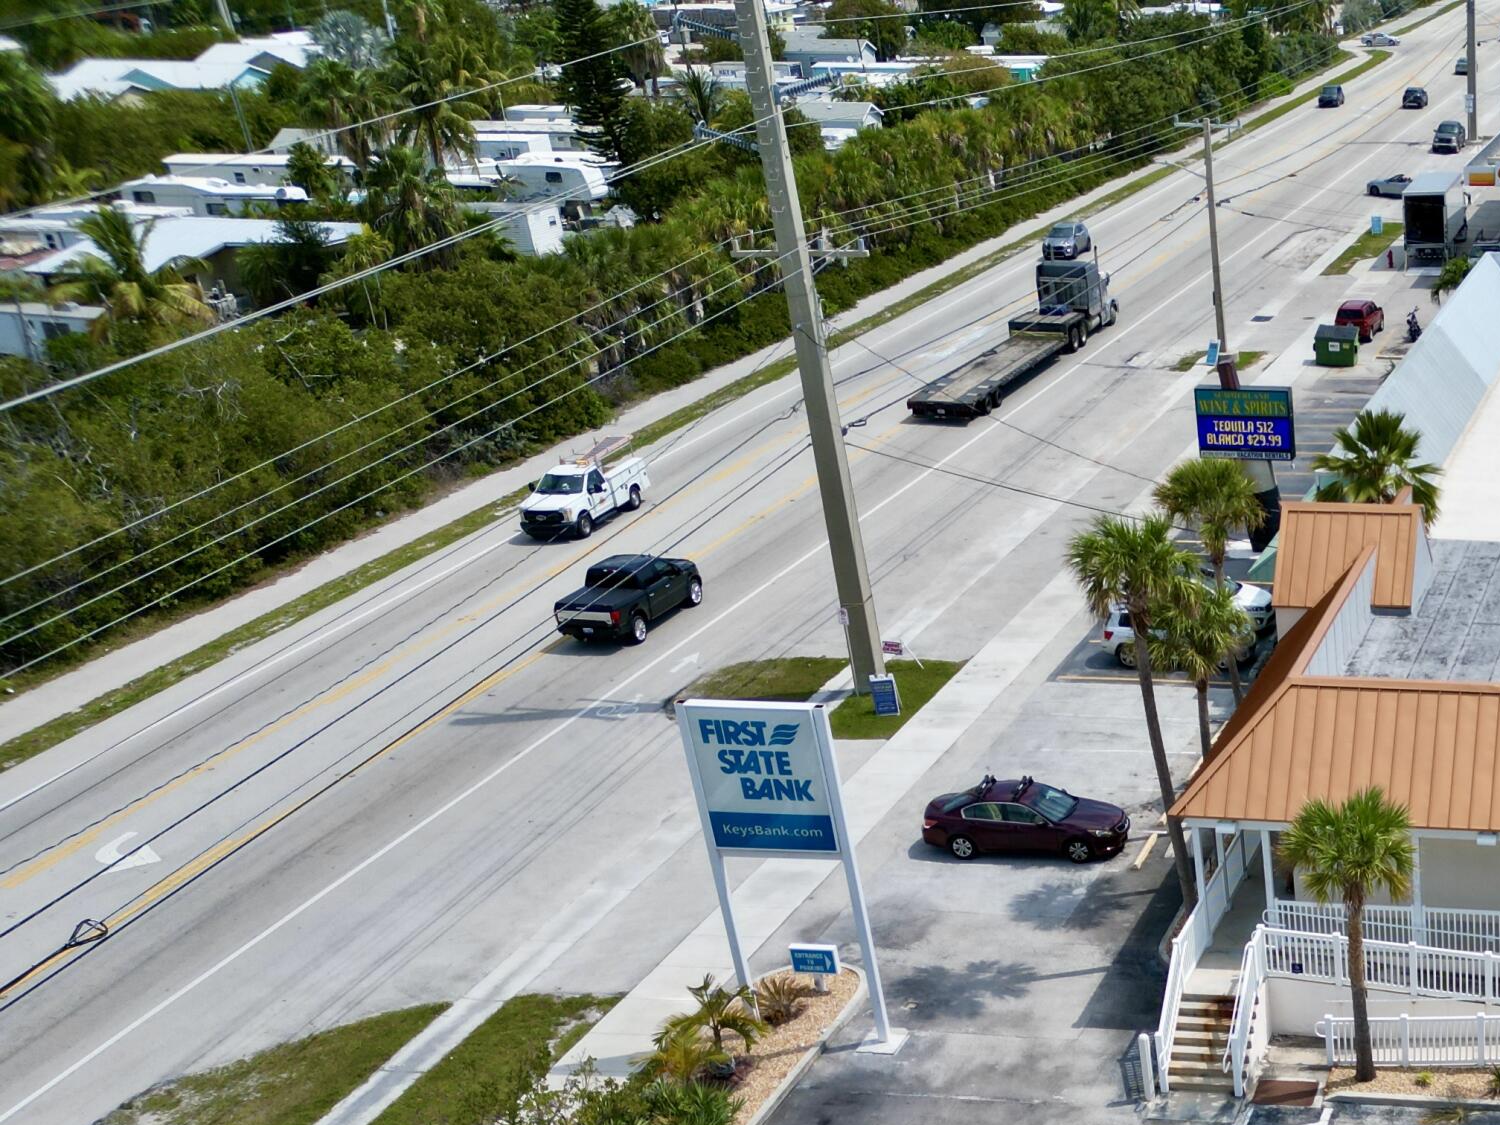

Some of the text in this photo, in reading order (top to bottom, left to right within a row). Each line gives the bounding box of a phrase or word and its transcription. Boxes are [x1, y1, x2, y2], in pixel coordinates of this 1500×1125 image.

[1200, 400, 1287, 415] WINE & SPIRITS
[1212, 420, 1274, 434] TEQUILA 512
[1206, 433, 1282, 447] BLANCO $29.99
[698, 718, 767, 747] FIRST
[717, 749, 793, 776] STATE
[739, 777, 816, 802] BANK
[722, 823, 824, 838] KeysBank.com
